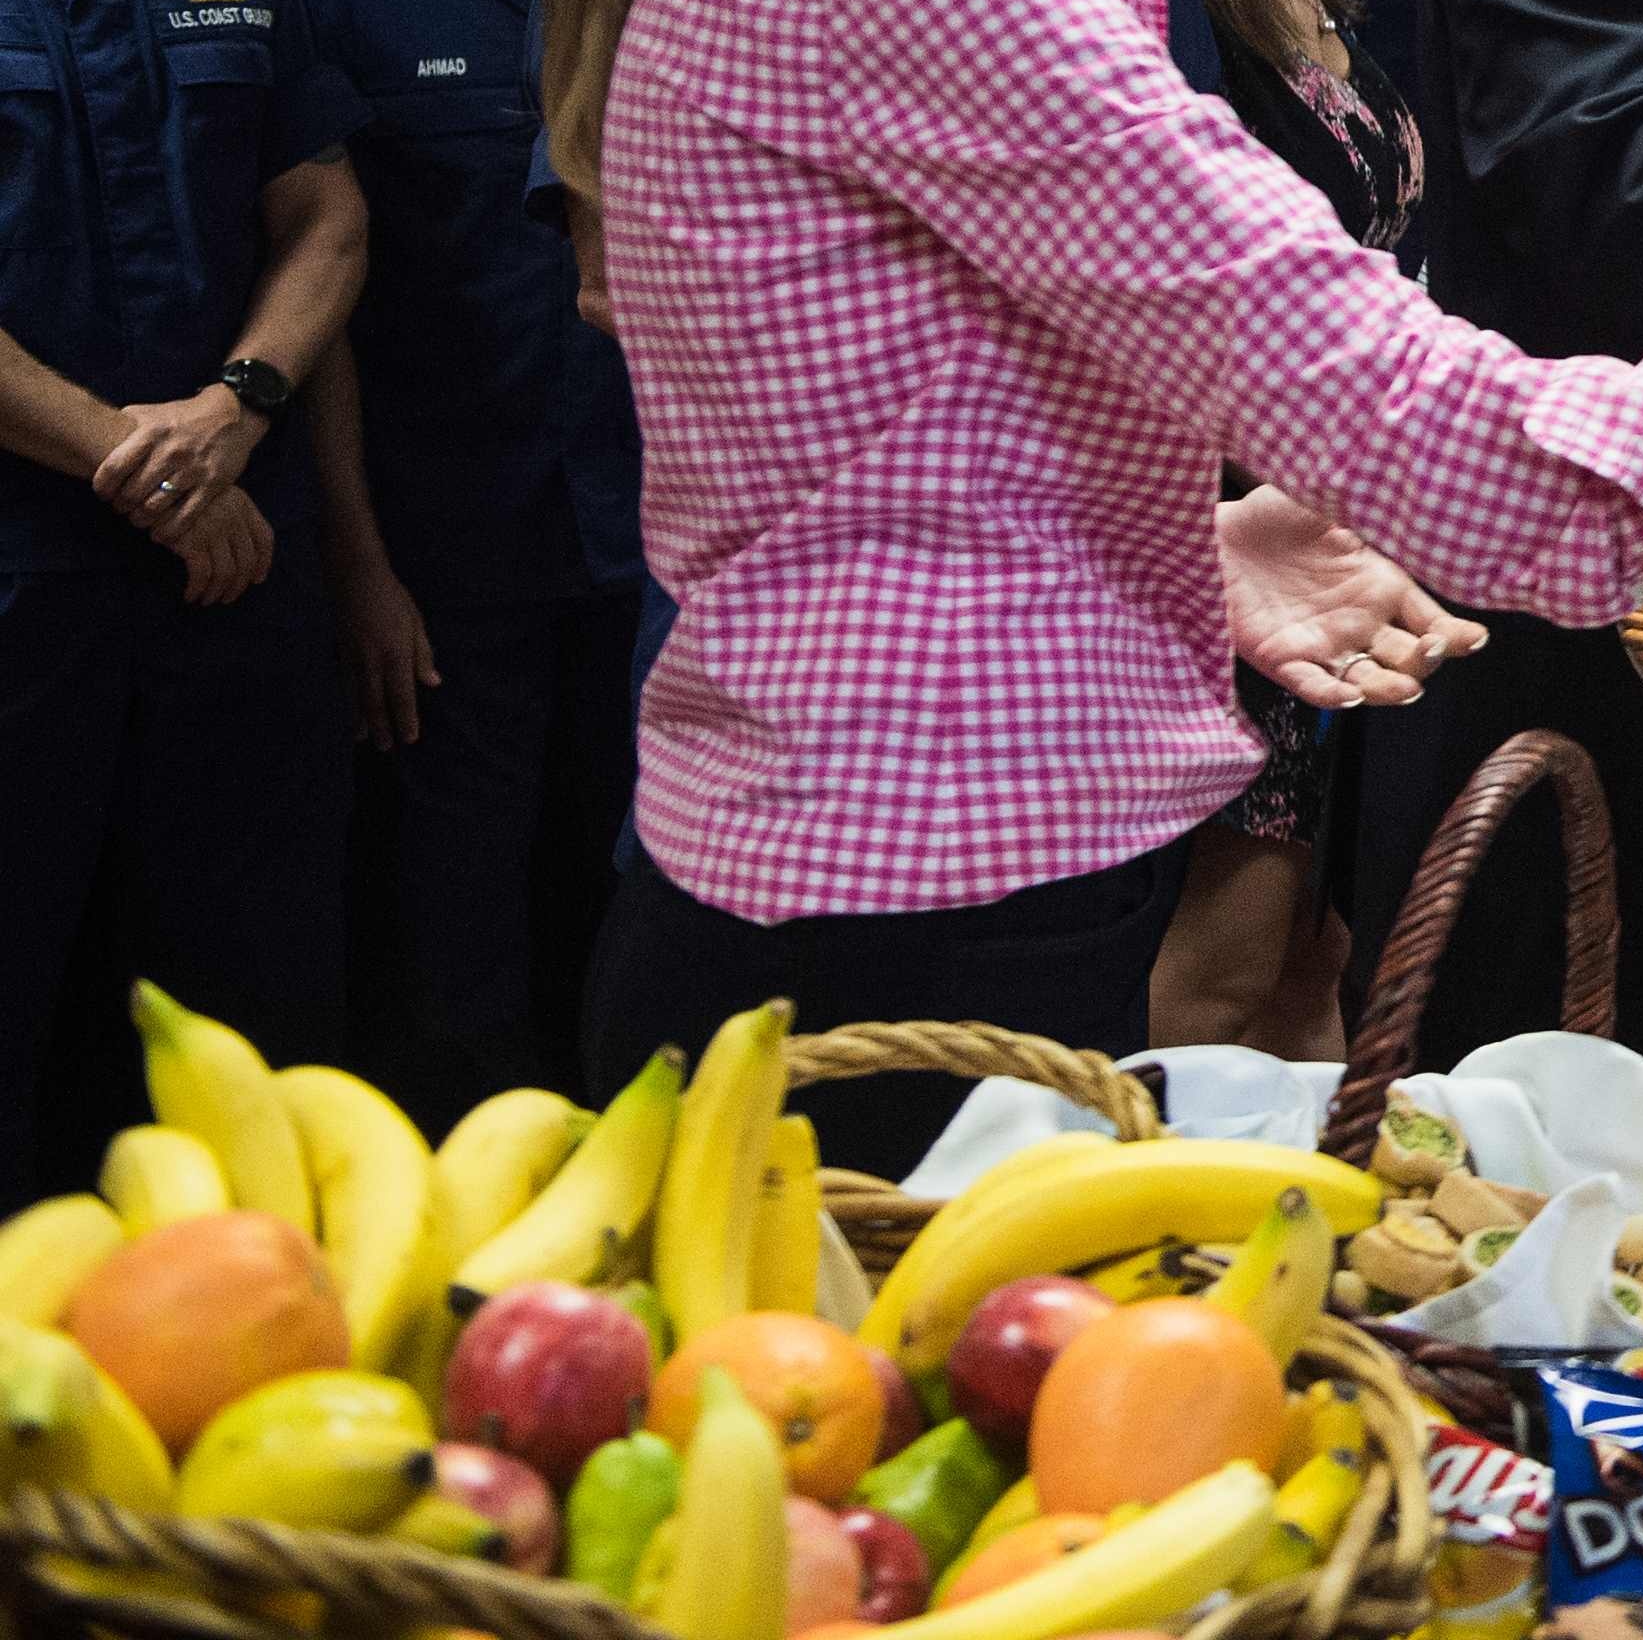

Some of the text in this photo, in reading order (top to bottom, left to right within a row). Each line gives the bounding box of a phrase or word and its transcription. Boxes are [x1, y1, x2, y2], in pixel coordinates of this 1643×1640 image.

[168, 10, 199, 28] U.S.
[198, 7, 240, 26] COAST
[417, 57, 466, 77] AHMAD
